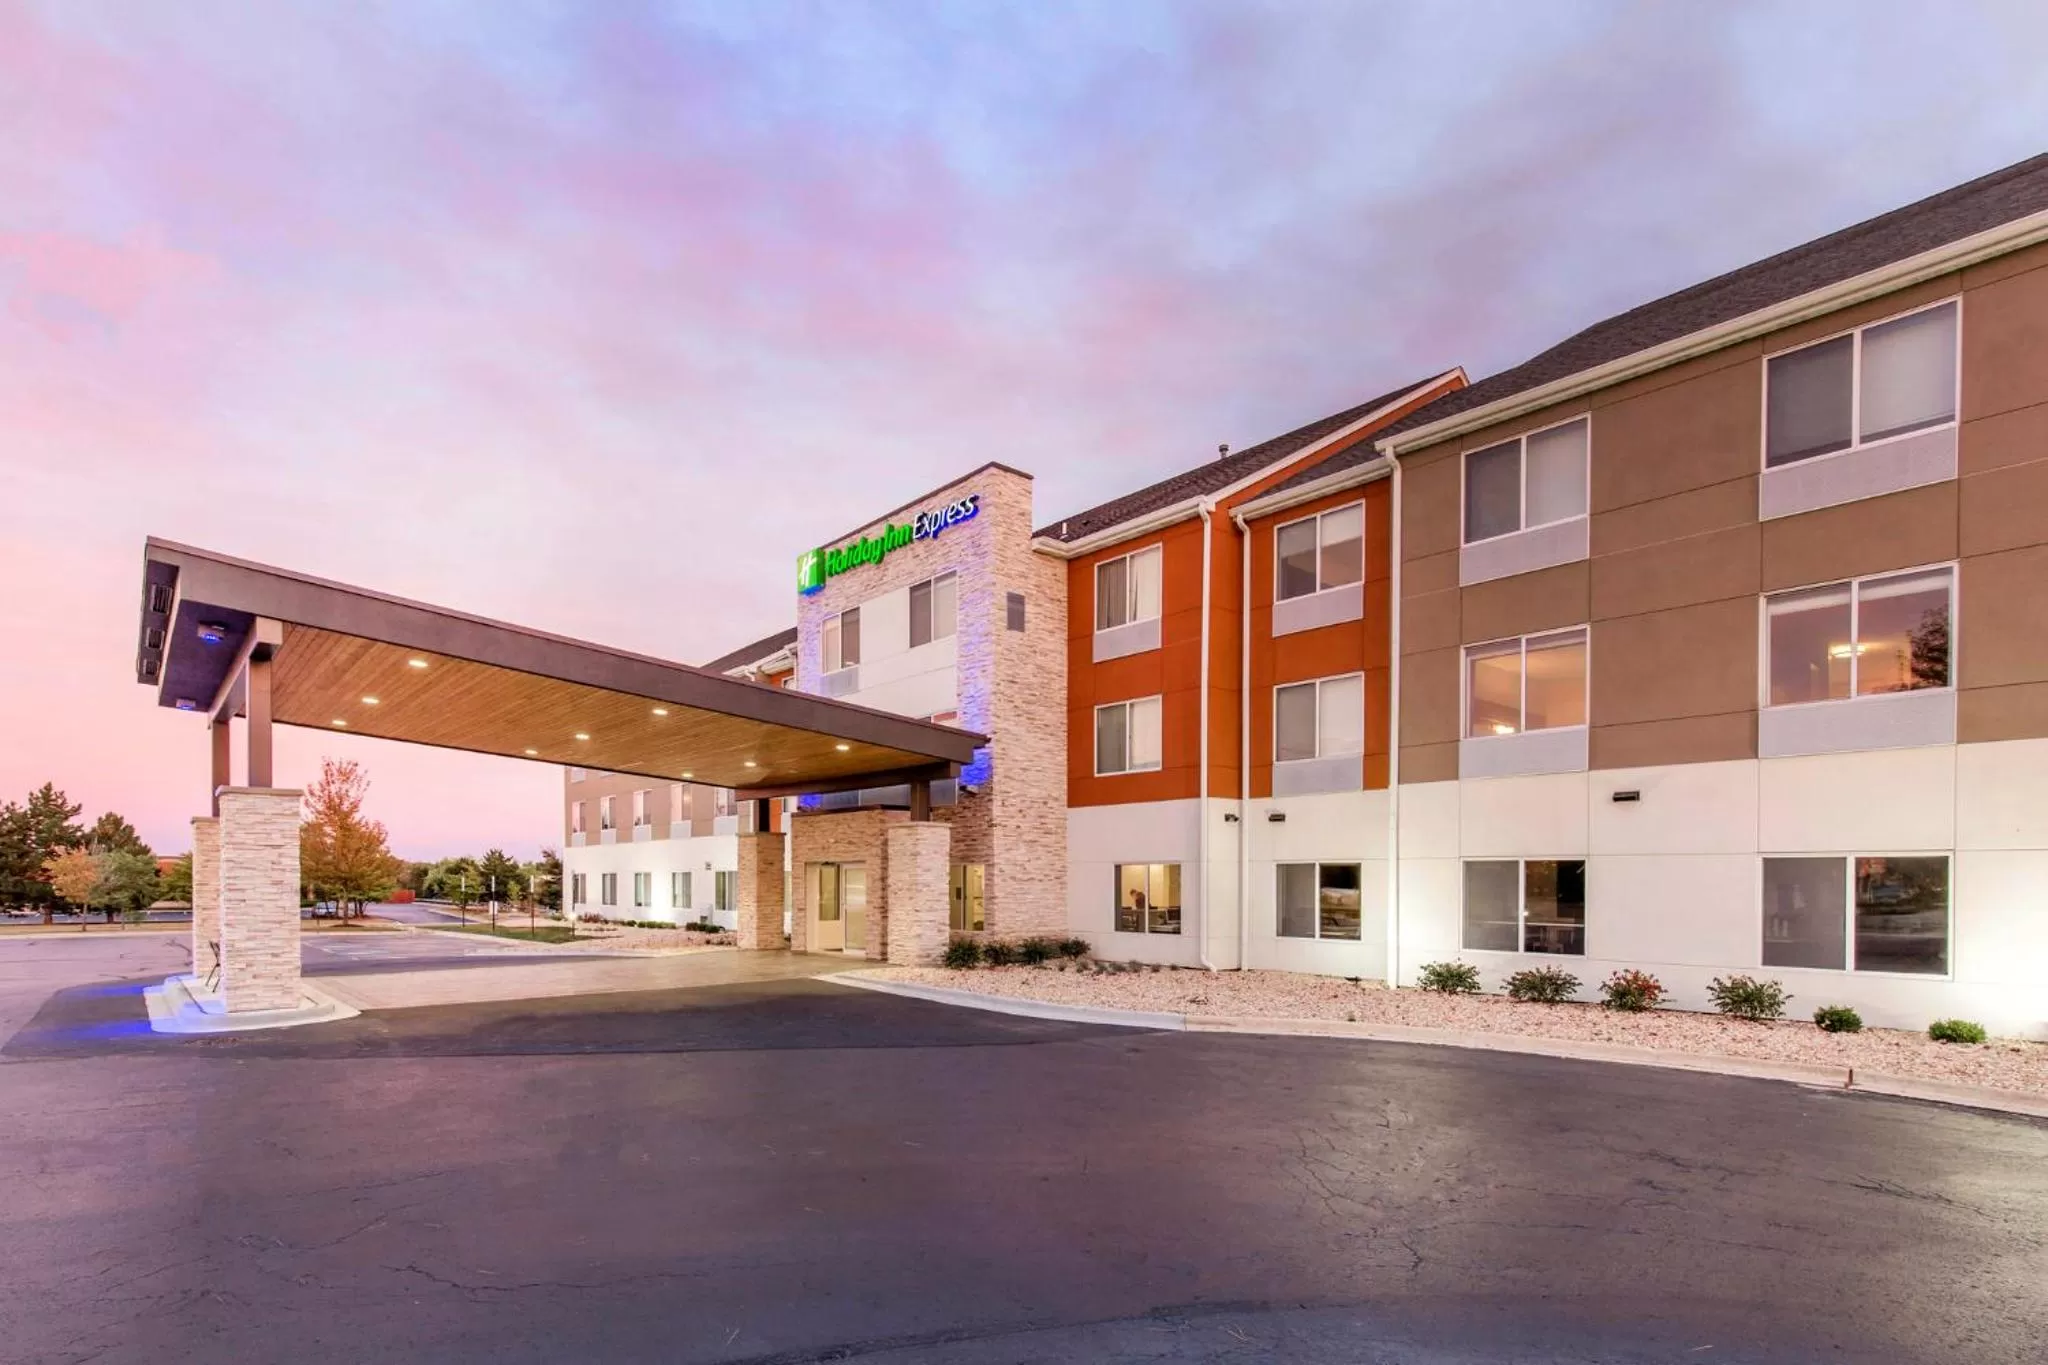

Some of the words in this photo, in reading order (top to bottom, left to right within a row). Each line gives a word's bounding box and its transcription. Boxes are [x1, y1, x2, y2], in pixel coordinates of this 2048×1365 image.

[825, 536, 885, 577] Holiday
[884, 522, 914, 552] Inn
[912, 494, 979, 540] Express
